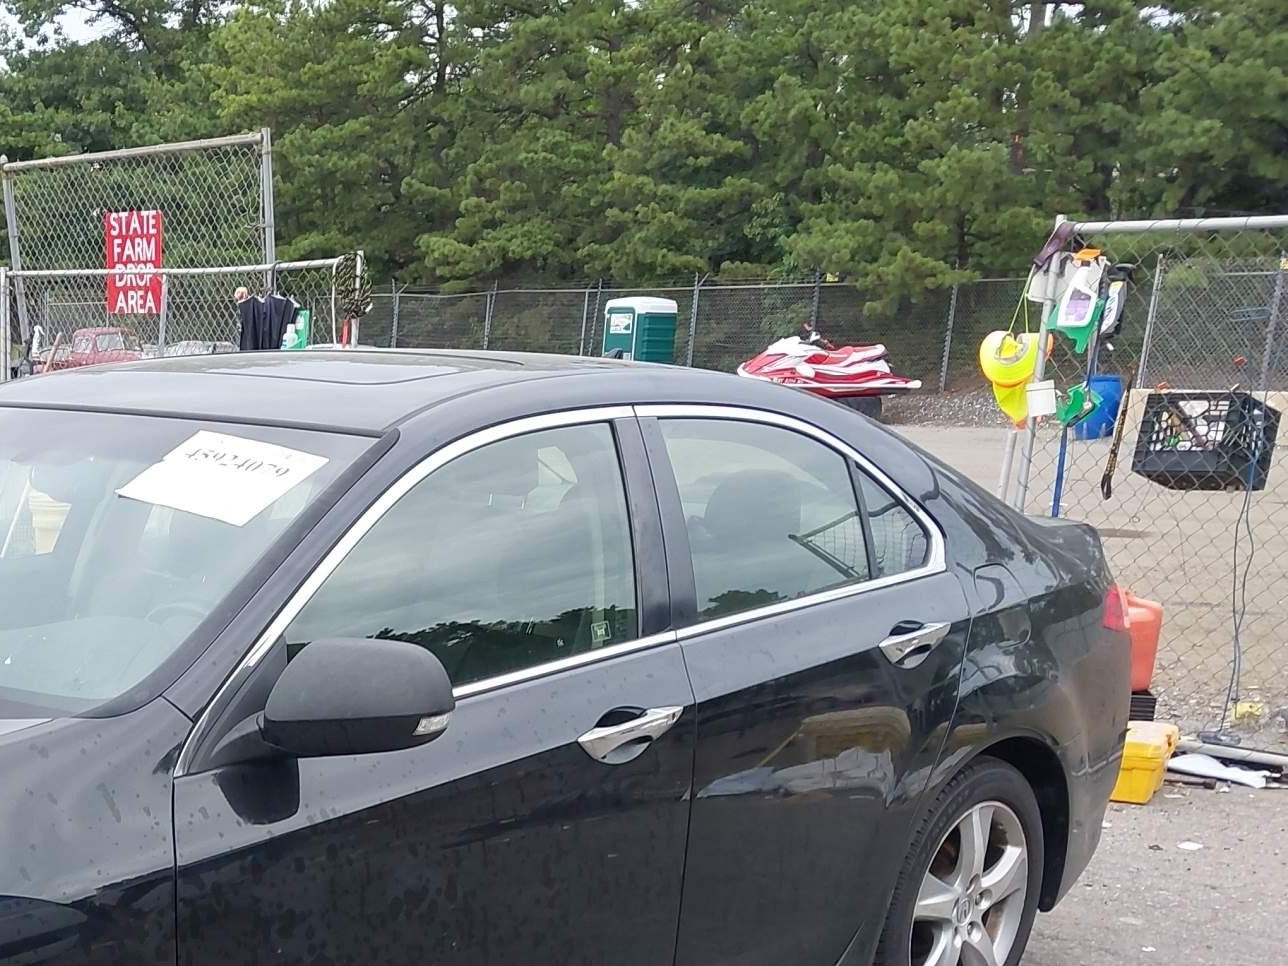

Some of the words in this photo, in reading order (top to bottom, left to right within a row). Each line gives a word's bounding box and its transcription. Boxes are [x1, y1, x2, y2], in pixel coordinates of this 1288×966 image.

[109, 209, 158, 236] STATE
[113, 237, 155, 262] FARM
[114, 263, 156, 287] DROP
[114, 290, 156, 313] AREA
